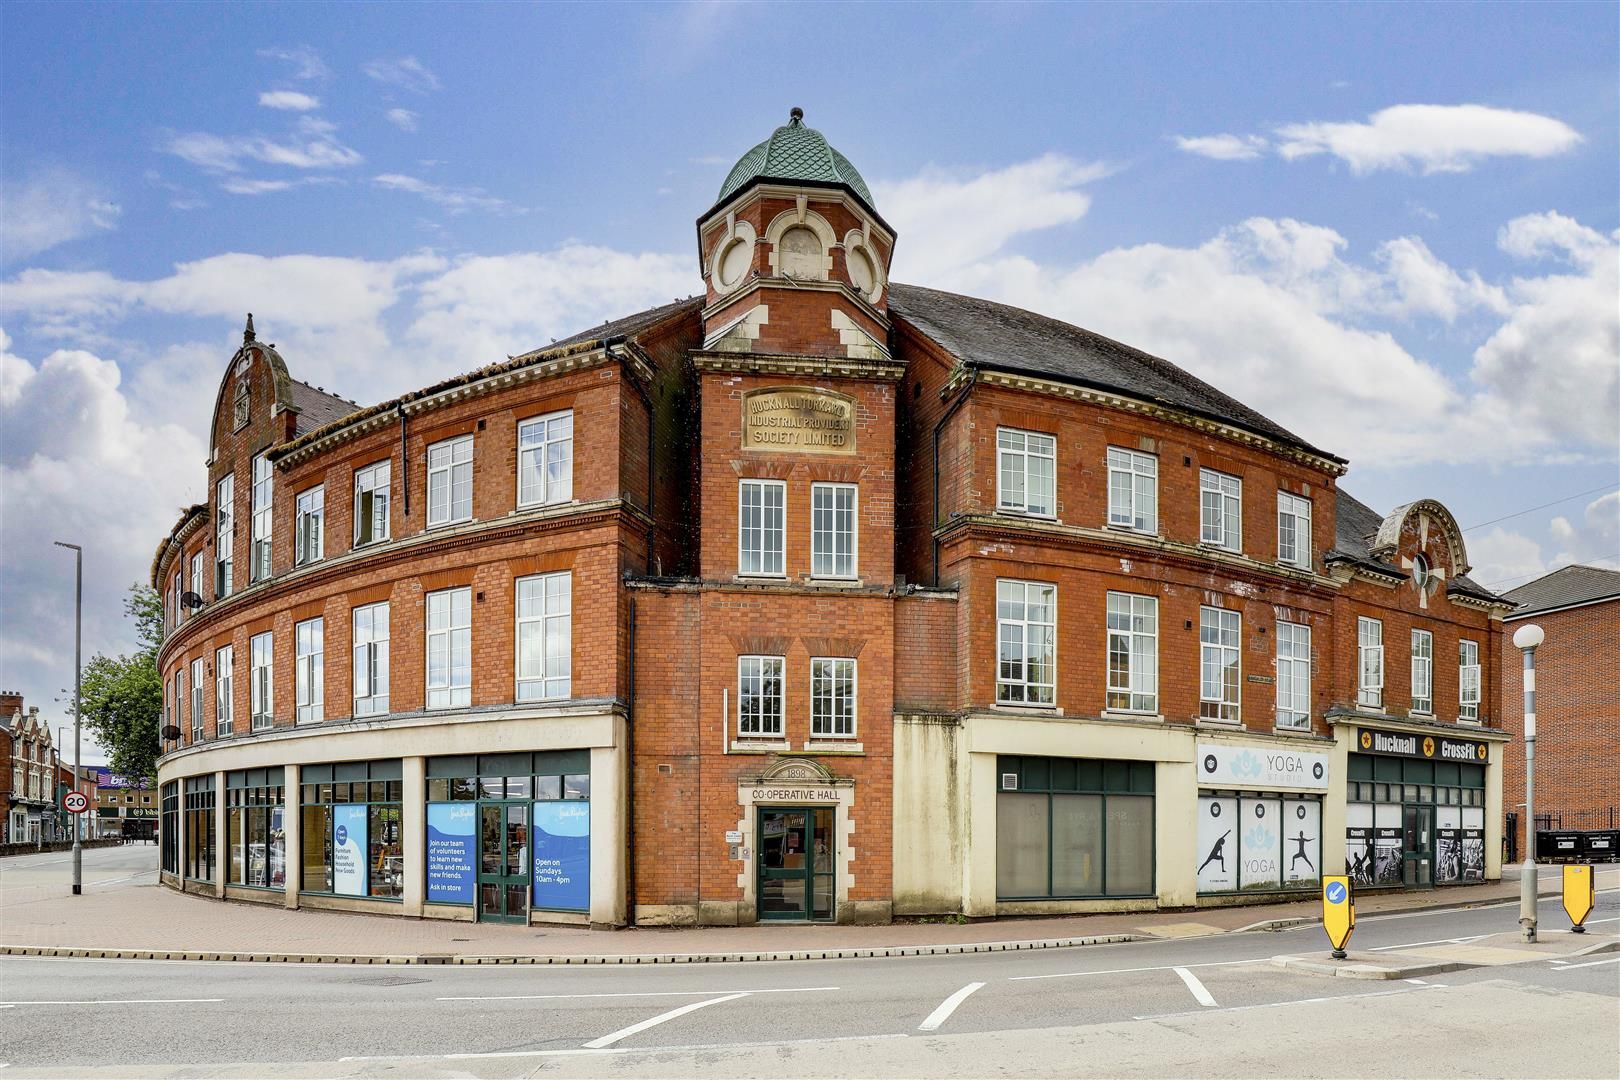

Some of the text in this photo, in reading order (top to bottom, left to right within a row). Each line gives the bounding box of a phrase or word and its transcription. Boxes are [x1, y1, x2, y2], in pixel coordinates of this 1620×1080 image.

[750, 416, 800, 428] INDUSTRIAL
[754, 431, 845, 446] SOCIETY LIMITED
[1374, 733, 1416, 754] Hucknall
[1442, 740, 1476, 760] CrossFit
[1266, 755, 1304, 772] YOGA
[788, 769, 806, 778] 1898
[818, 790, 840, 800] HALL
[67, 798, 85, 806] 20
[536, 867, 561, 875] Sundays
[1244, 860, 1276, 873] YOGA
[557, 876, 570, 884] 4pm
